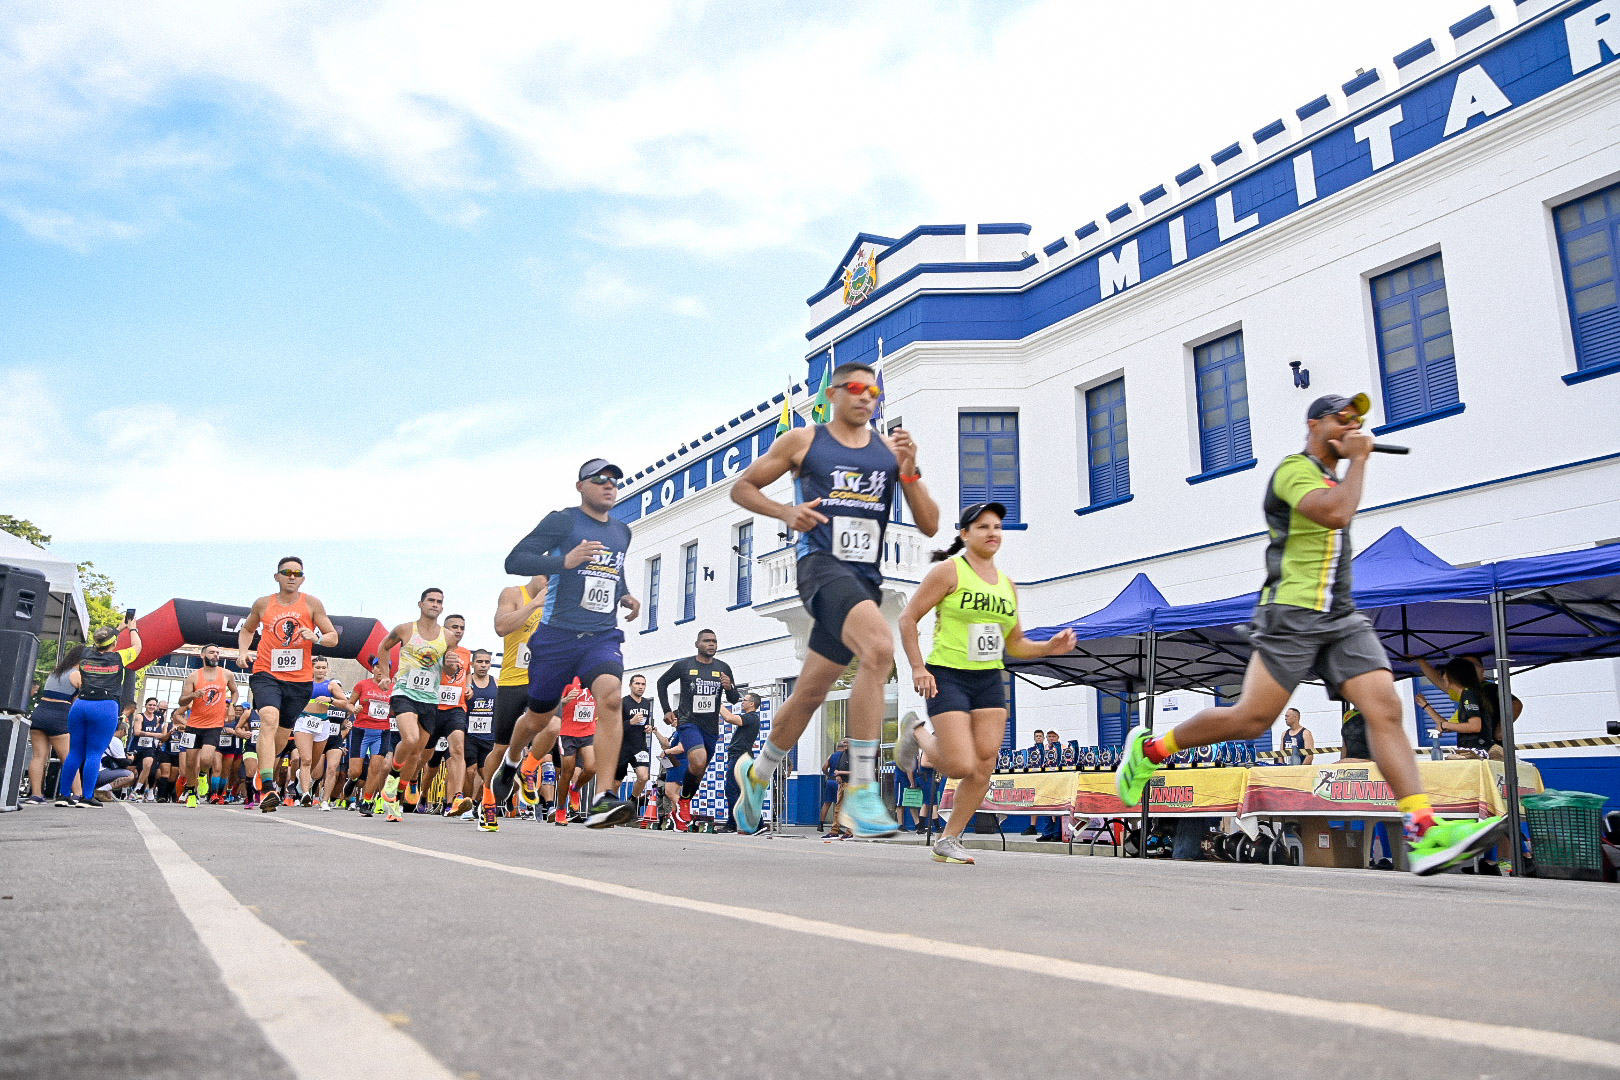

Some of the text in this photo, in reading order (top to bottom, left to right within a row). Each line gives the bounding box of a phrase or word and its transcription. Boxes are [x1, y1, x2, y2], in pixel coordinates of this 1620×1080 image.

[1098, 0, 1620, 300] MILITAR
[641, 435, 758, 519] POLICI
[589, 588, 609, 603] 005
[277, 656, 297, 666] 092
[414, 676, 430, 686] 012
[441, 692, 456, 700] 065
[1331, 781, 1396, 800] RUNNIN
